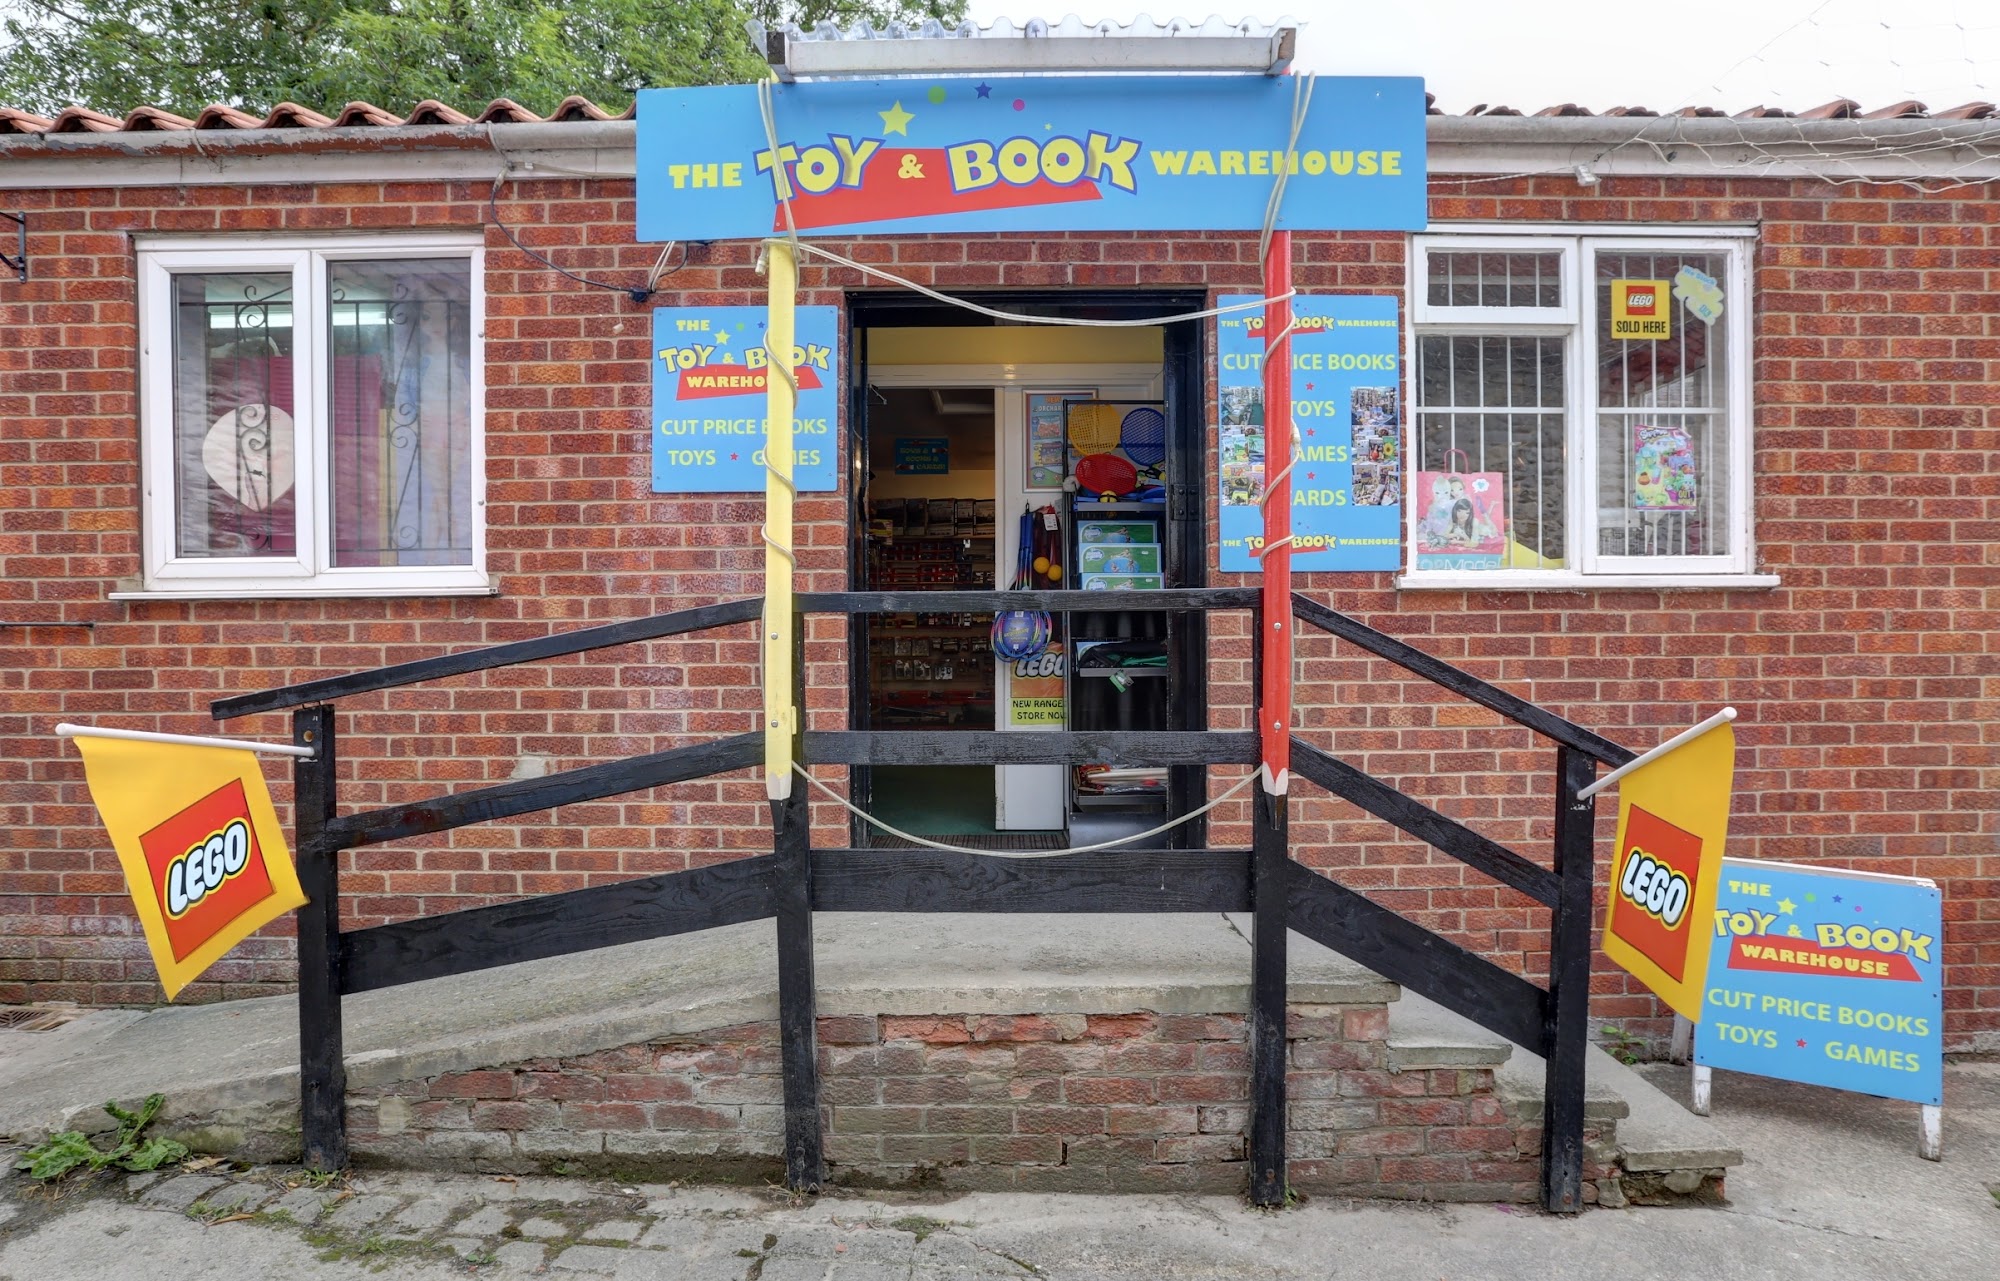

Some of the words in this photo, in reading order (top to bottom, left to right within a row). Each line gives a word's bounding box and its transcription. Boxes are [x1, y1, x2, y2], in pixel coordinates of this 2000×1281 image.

[668, 163, 742, 189] THE
[753, 133, 886, 205] TOY
[898, 154, 926, 179] &
[944, 129, 1143, 195] BOOK
[1150, 150, 1402, 176] WAREHOUSE
[1627, 295, 1654, 307] LEGO
[676, 320, 710, 331] THE
[1242, 316, 1265, 331] TO
[1337, 319, 1397, 327] WAREHOUSE
[1616, 321, 1639, 333] SOLD
[1643, 321, 1666, 333] HERE
[658, 343, 717, 373] TOY
[722, 352, 736, 364] &
[744, 343, 831, 371] BOK
[1222, 353, 1262, 370] CUT
[1293, 354, 1323, 370] ICE
[1328, 353, 1396, 370] BOOKS
[686, 376, 799, 388] WAREHO
[661, 419, 698, 435] CUT
[703, 419, 756, 434] PRICE
[761, 418, 827, 434] OKS
[668, 450, 716, 466] TOYS
[752, 449, 820, 466] GES
[1299, 445, 1347, 462] MES
[1293, 488, 1346, 506] ARDS
[1244, 536, 1264, 551] TO
[1291, 534, 1337, 549] BOOK
[1017, 712, 1044, 720] STORE
[167, 820, 249, 917] LEGO
[1619, 849, 1689, 927] LEGO
[1728, 880, 1772, 897] THE
[1714, 908, 1780, 937] TOY
[1786, 924, 1803, 938] &
[1814, 923, 1934, 963] BOOK
[1740, 944, 1889, 976] WAREHOUSE
[1708, 988, 1756, 1010] CUT
[1761, 995, 1831, 1022] PRICE
[1838, 1006, 1929, 1036] BOOKS
[1716, 1022, 1778, 1048] TOYS
[1825, 1041, 1920, 1072] GAMES
